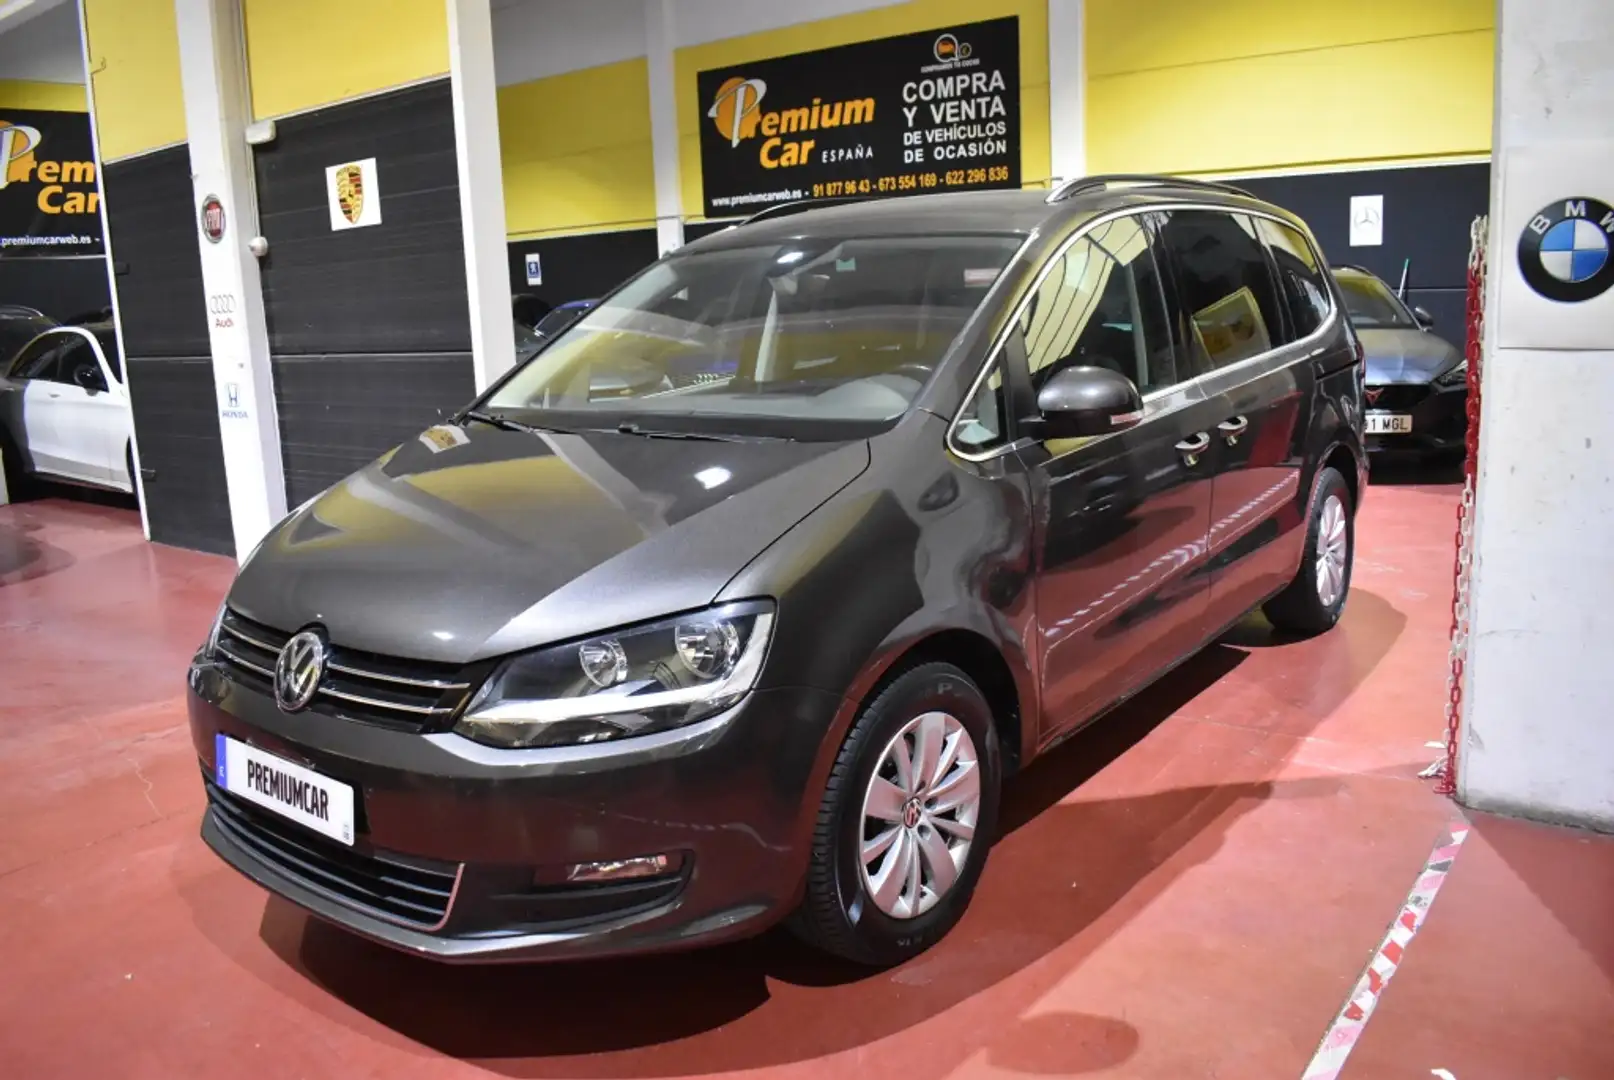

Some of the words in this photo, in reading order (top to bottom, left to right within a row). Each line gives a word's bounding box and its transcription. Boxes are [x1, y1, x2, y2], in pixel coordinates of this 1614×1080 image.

[902, 70, 1006, 103] COMPRA
[708, 78, 875, 148] Premium
[902, 106, 918, 128] Y
[930, 95, 1006, 124] VENTA
[903, 131, 922, 146] DE
[925, 121, 1006, 143] VEHÍCULOS
[760, 137, 816, 169] Car
[821, 144, 874, 163] ESPAÑA
[904, 148, 924, 164] DE
[934, 138, 1006, 160] OCASIÓN
[38, 185, 100, 214] Car
[712, 188, 802, 207] www.premiumcarweb.es
[813, 183, 824, 197] 91
[858, 179, 870, 193] 43
[1382, 417, 1409, 430] MGL
[247, 758, 329, 822] PREMIUMCAR
